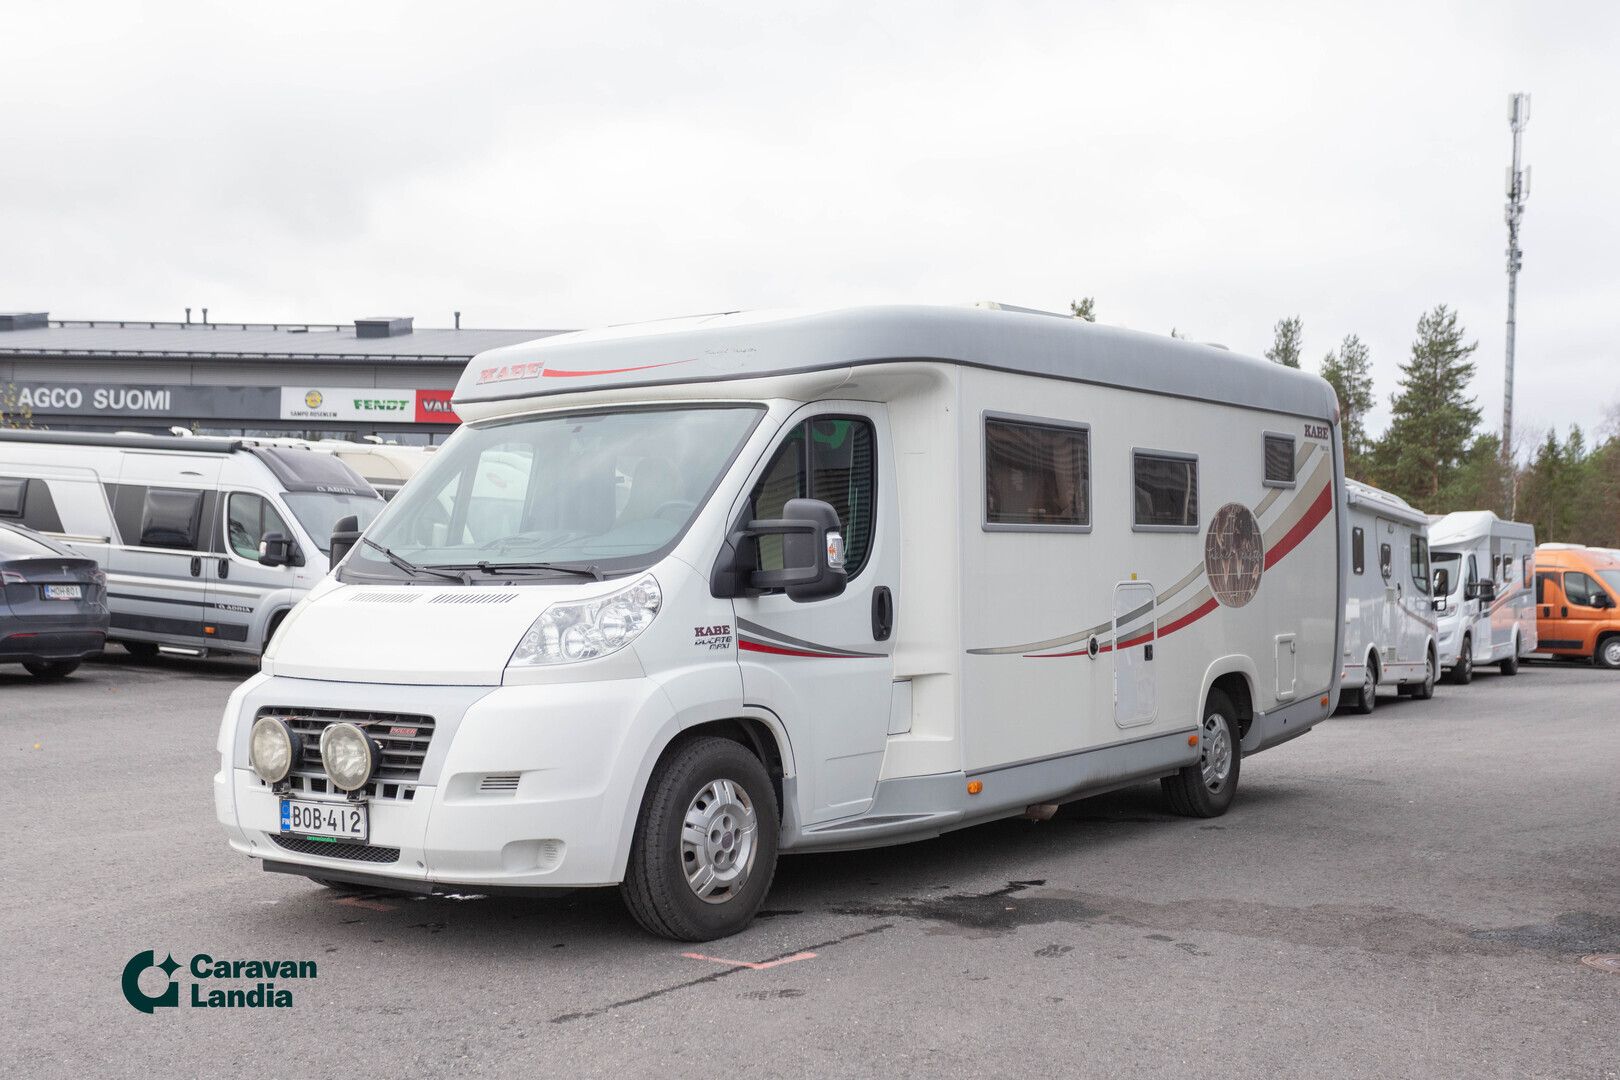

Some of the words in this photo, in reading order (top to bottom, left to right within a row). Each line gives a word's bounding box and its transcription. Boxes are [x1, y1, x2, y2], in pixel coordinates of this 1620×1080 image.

[18, 387, 83, 409] AGCO
[93, 389, 171, 411] SUOMI
[353, 399, 409, 411] FENDT
[1304, 424, 1328, 439] KABE
[694, 625, 730, 637] KABE
[292, 805, 361, 833] BOB-412
